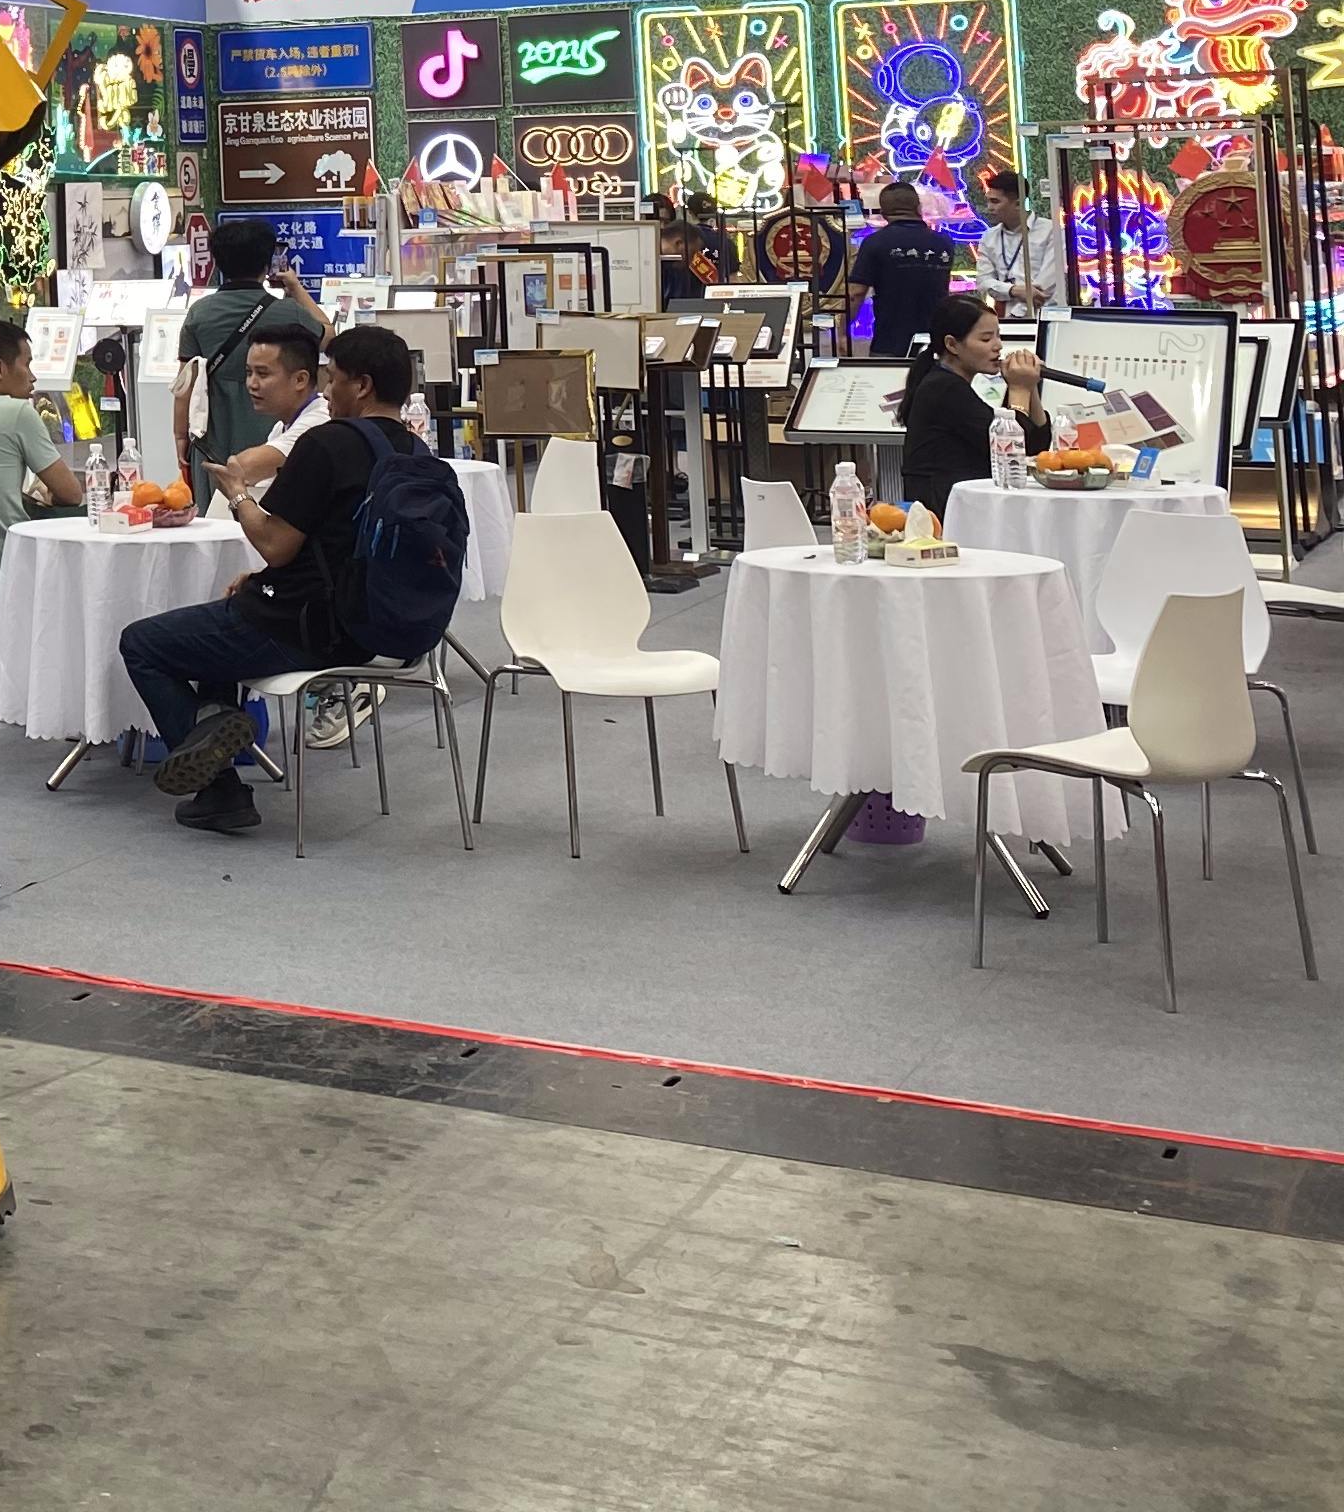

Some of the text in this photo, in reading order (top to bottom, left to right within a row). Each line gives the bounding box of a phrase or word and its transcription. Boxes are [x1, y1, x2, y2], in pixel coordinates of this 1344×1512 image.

[223, 106, 368, 134] 京甘泉生态农业科技园
[287, 133, 325, 144] agriculture
[325, 132, 352, 141] Science
[353, 131, 369, 140] Park
[183, 164, 191, 185] 5
[277, 221, 317, 235] 文化路
[191, 225, 212, 280] 停
